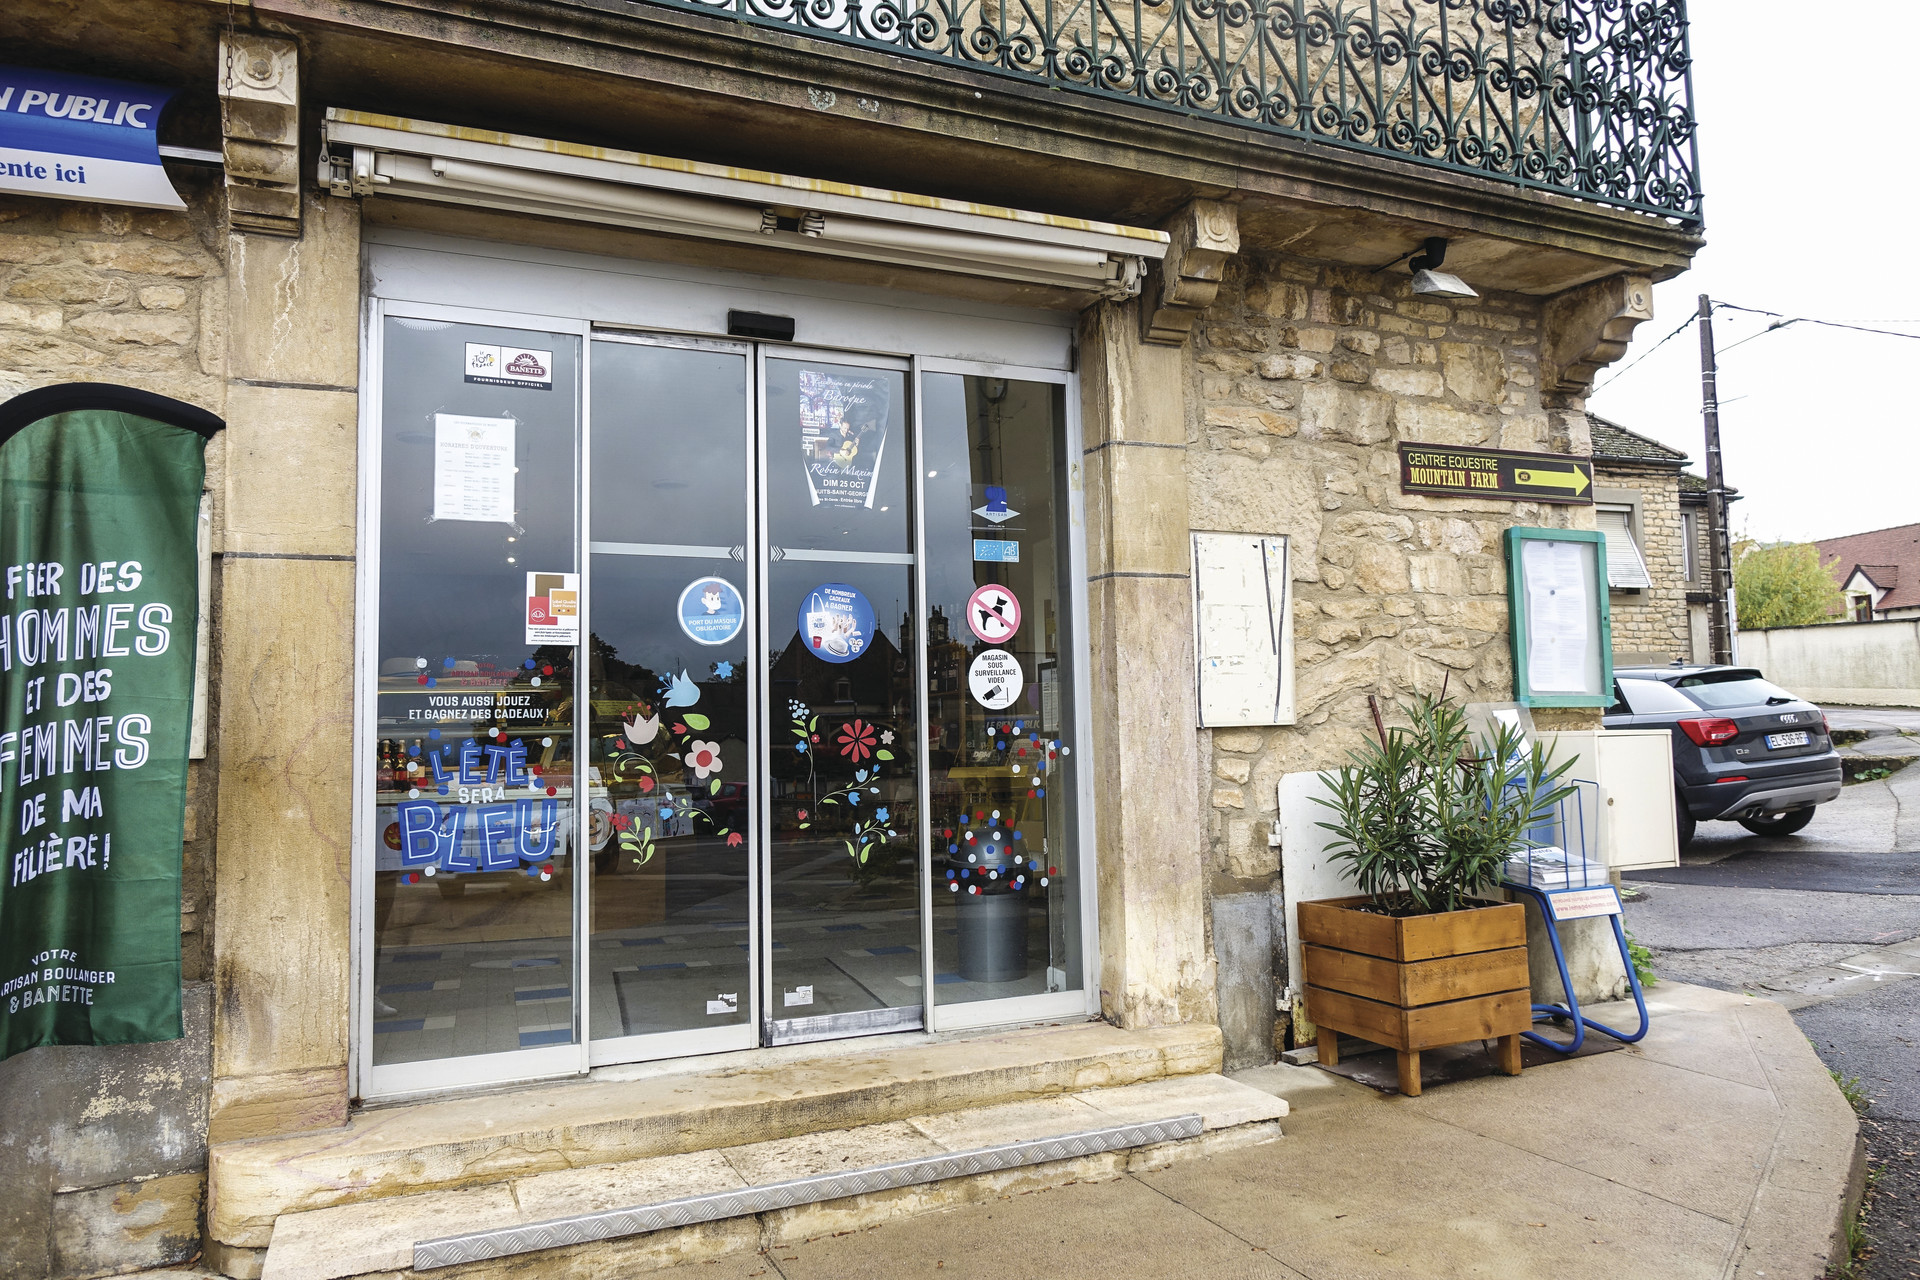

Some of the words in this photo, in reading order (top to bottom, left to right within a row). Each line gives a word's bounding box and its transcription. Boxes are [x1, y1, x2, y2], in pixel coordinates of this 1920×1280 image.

[17, 89, 152, 129] PUBLIC
[55, 163, 86, 184] ici
[510, 365, 543, 375] BANETTE
[473, 377, 515, 385] FOURNISSEUR
[823, 390, 866, 412] Baroque
[810, 460, 840, 477] Robin
[1408, 453, 1446, 467] CENTRE
[1448, 457, 1498, 471] EQUESTRE
[823, 479, 838, 487] DIM
[839, 480, 848, 488] 25
[849, 481, 865, 489] OCT
[1410, 467, 1466, 487] MOUNTAIN
[1470, 471, 1499, 489] FARM
[81, 560, 143, 594] DES
[829, 595, 851, 603] CADEAUX
[831, 589, 856, 598] NOMBREUX
[830, 603, 853, 612] GAGNER
[974, 669, 1017, 677] SURVEILLANCE
[26, 677, 45, 715] ET
[57, 669, 113, 707] DES
[429, 696, 458, 707] VOUS
[461, 696, 494, 707] AUSSI
[497, 695, 530, 706] JOUEZ
[409, 709, 422, 720] ET
[424, 709, 467, 720] GAGNEZ
[470, 709, 491, 719] DES
[494, 708, 544, 719] CADEAUX
[0, 713, 152, 792] FEMMES
[429, 738, 529, 785] L'ÉTÉ
[458, 786, 505, 804] SERA
[22, 793, 47, 835] DE
[62, 786, 103, 823] MA
[398, 798, 557, 873] BLEU
[32, 949, 78, 966] VOTRE
[43, 967, 116, 983] BOULANGER
[10, 996, 20, 1014] &
[23, 985, 94, 1008] BANETTE
